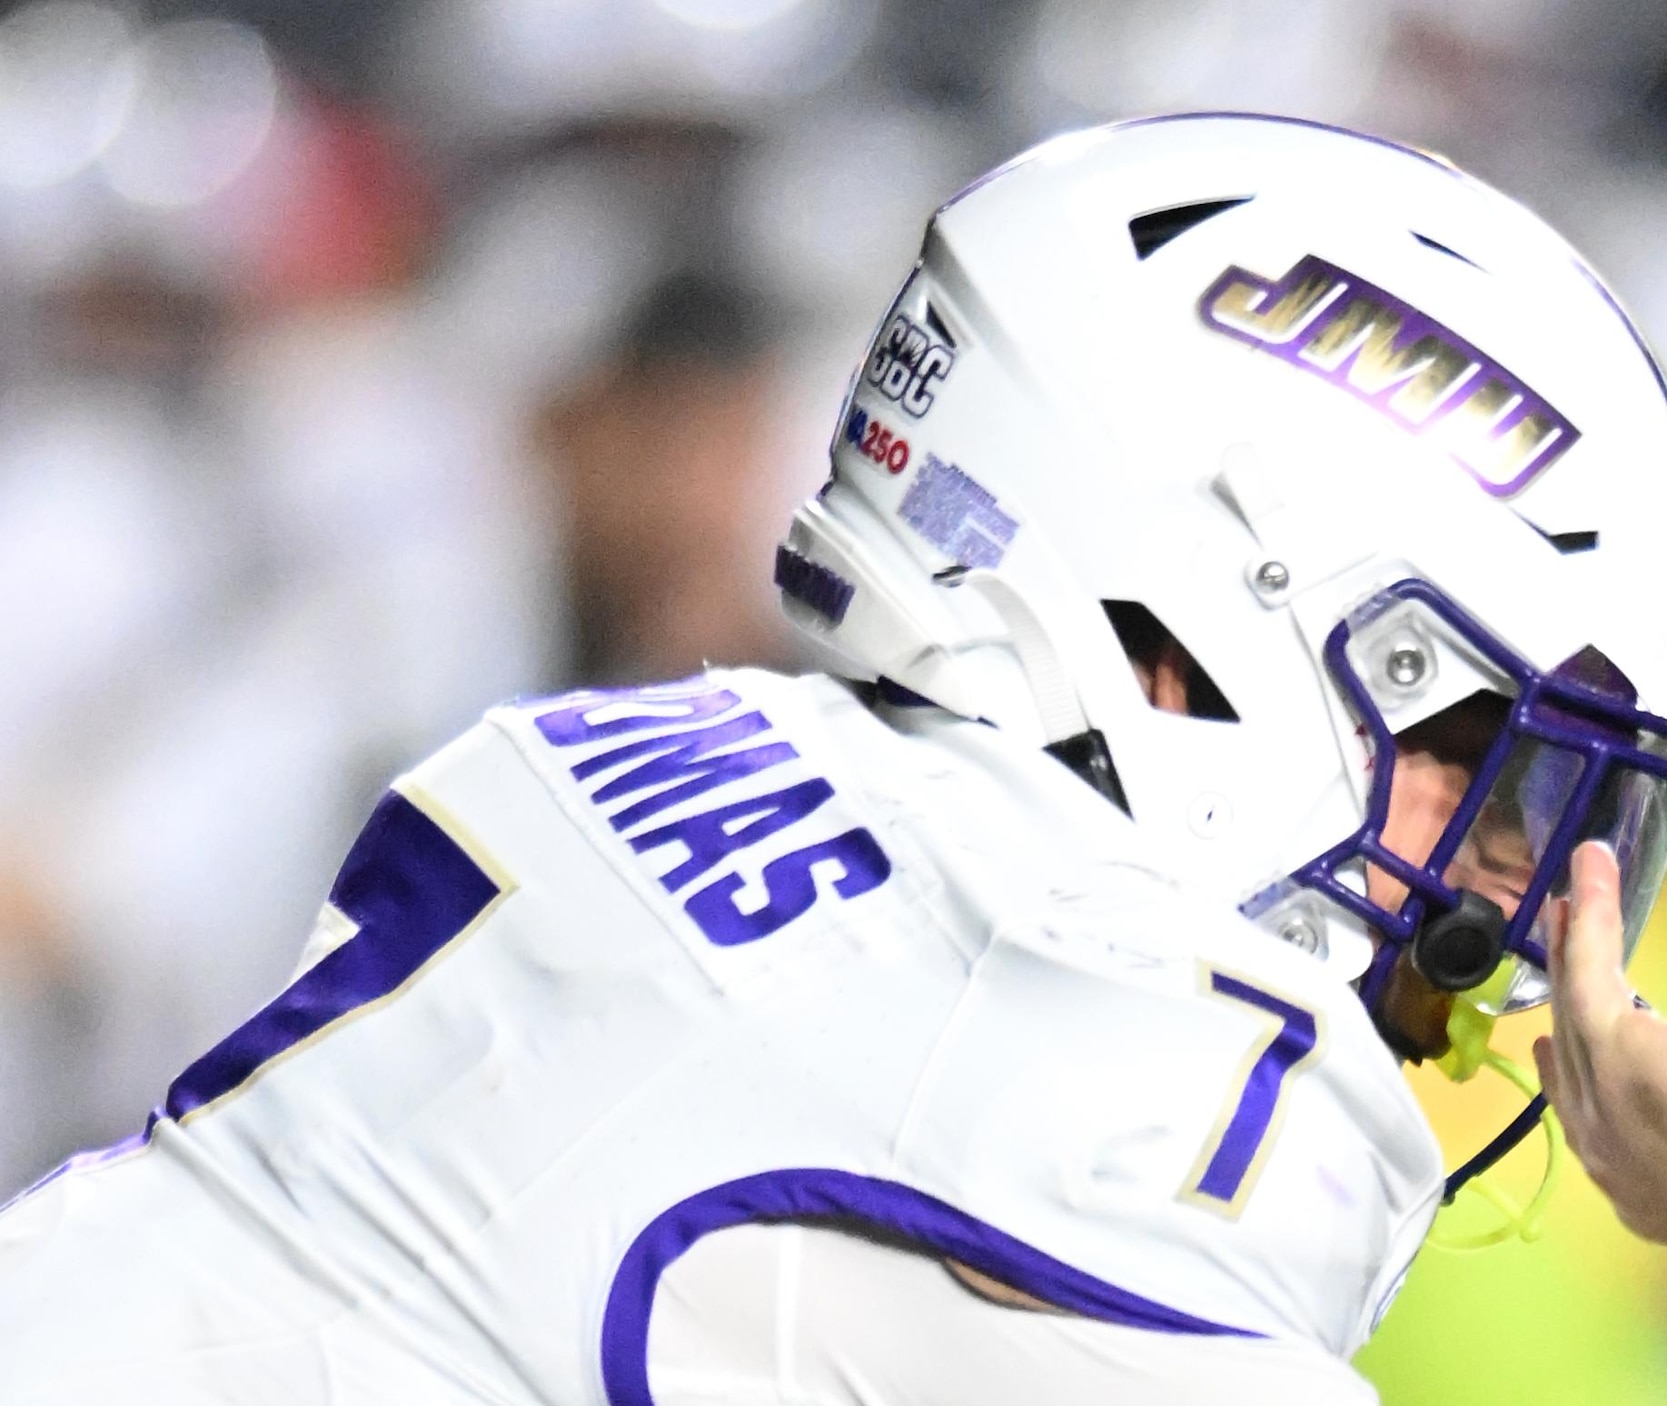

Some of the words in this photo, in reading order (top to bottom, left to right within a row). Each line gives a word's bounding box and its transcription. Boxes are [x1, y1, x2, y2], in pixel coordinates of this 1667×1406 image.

[867, 314, 957, 418] SBC
[1196, 255, 1582, 499] JMU
[533, 684, 892, 947] OMAS
[1176, 957, 1329, 1223] 7
